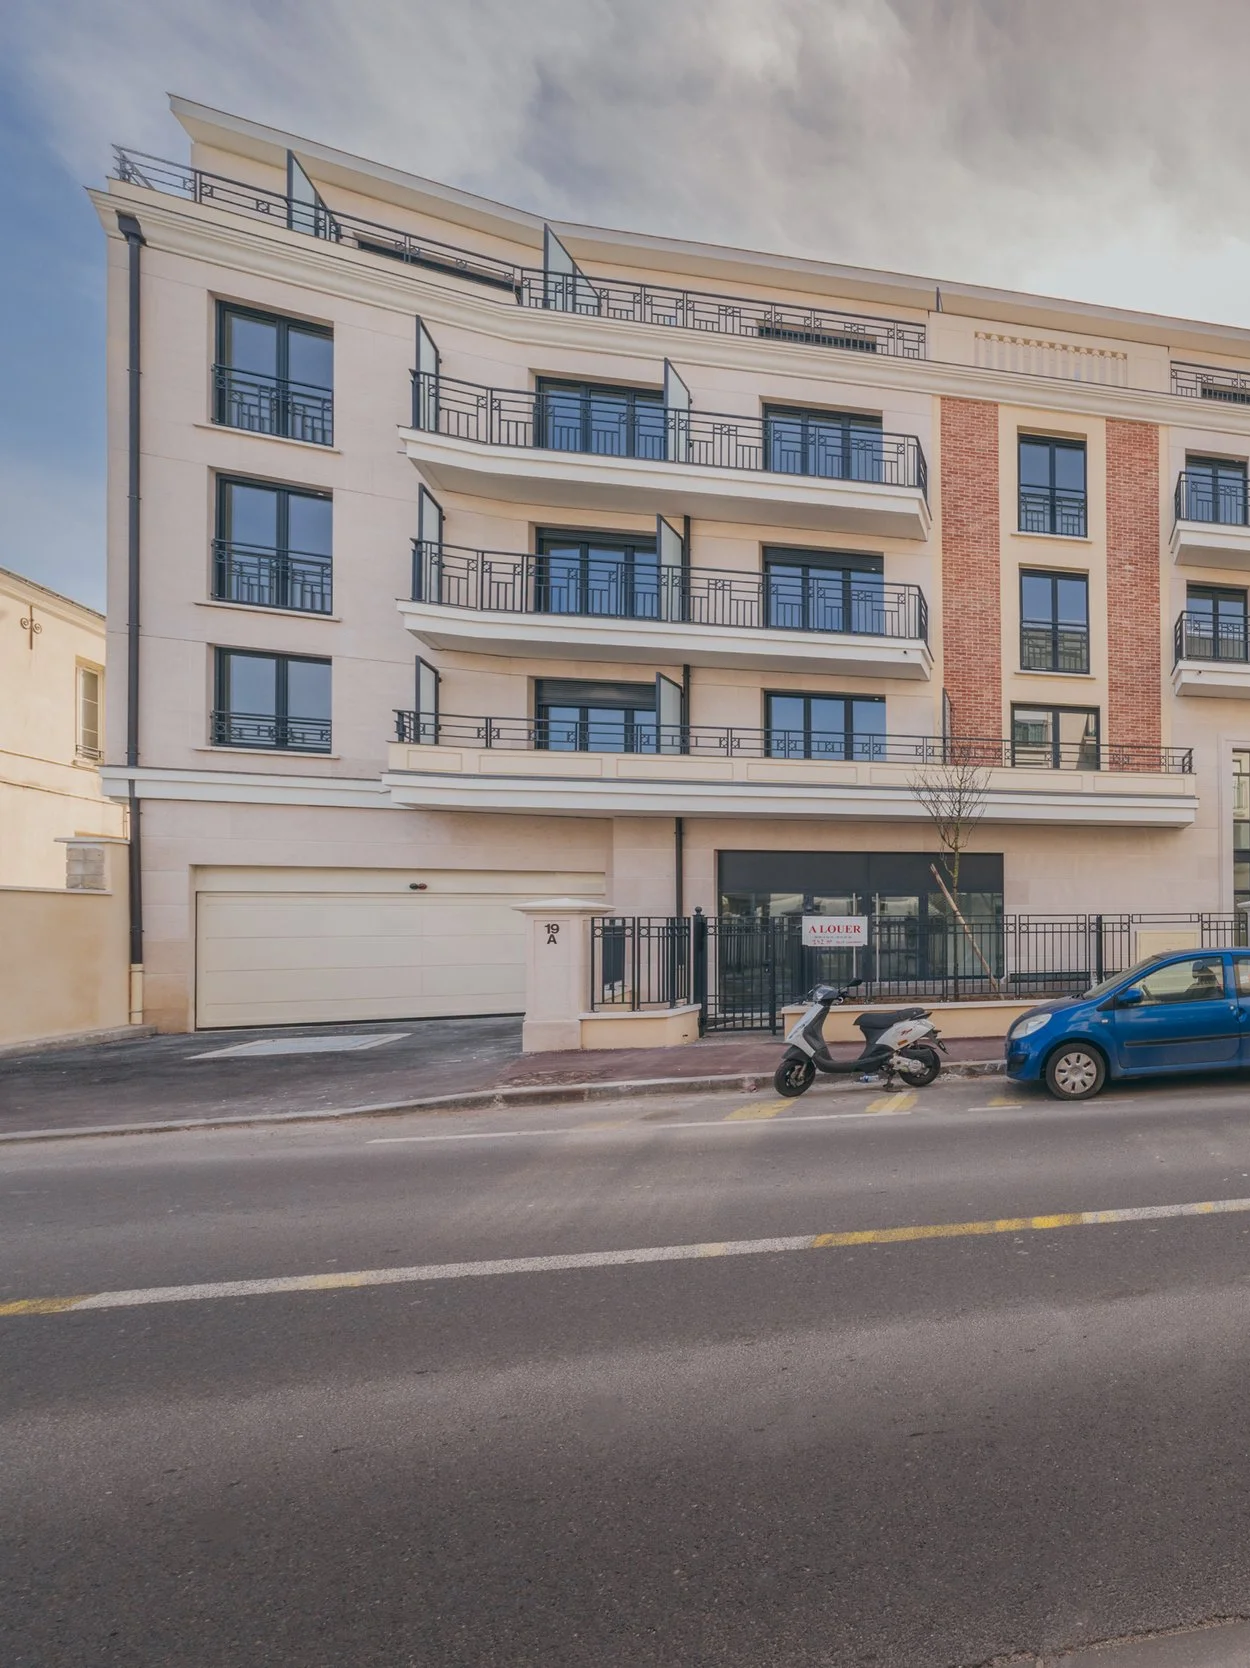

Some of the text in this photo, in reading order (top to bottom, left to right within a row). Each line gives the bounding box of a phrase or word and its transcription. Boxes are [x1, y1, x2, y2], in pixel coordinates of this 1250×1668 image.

[544, 923, 560, 934] 19
[808, 924, 861, 933] A LOUER
[546, 934, 557, 944] A
